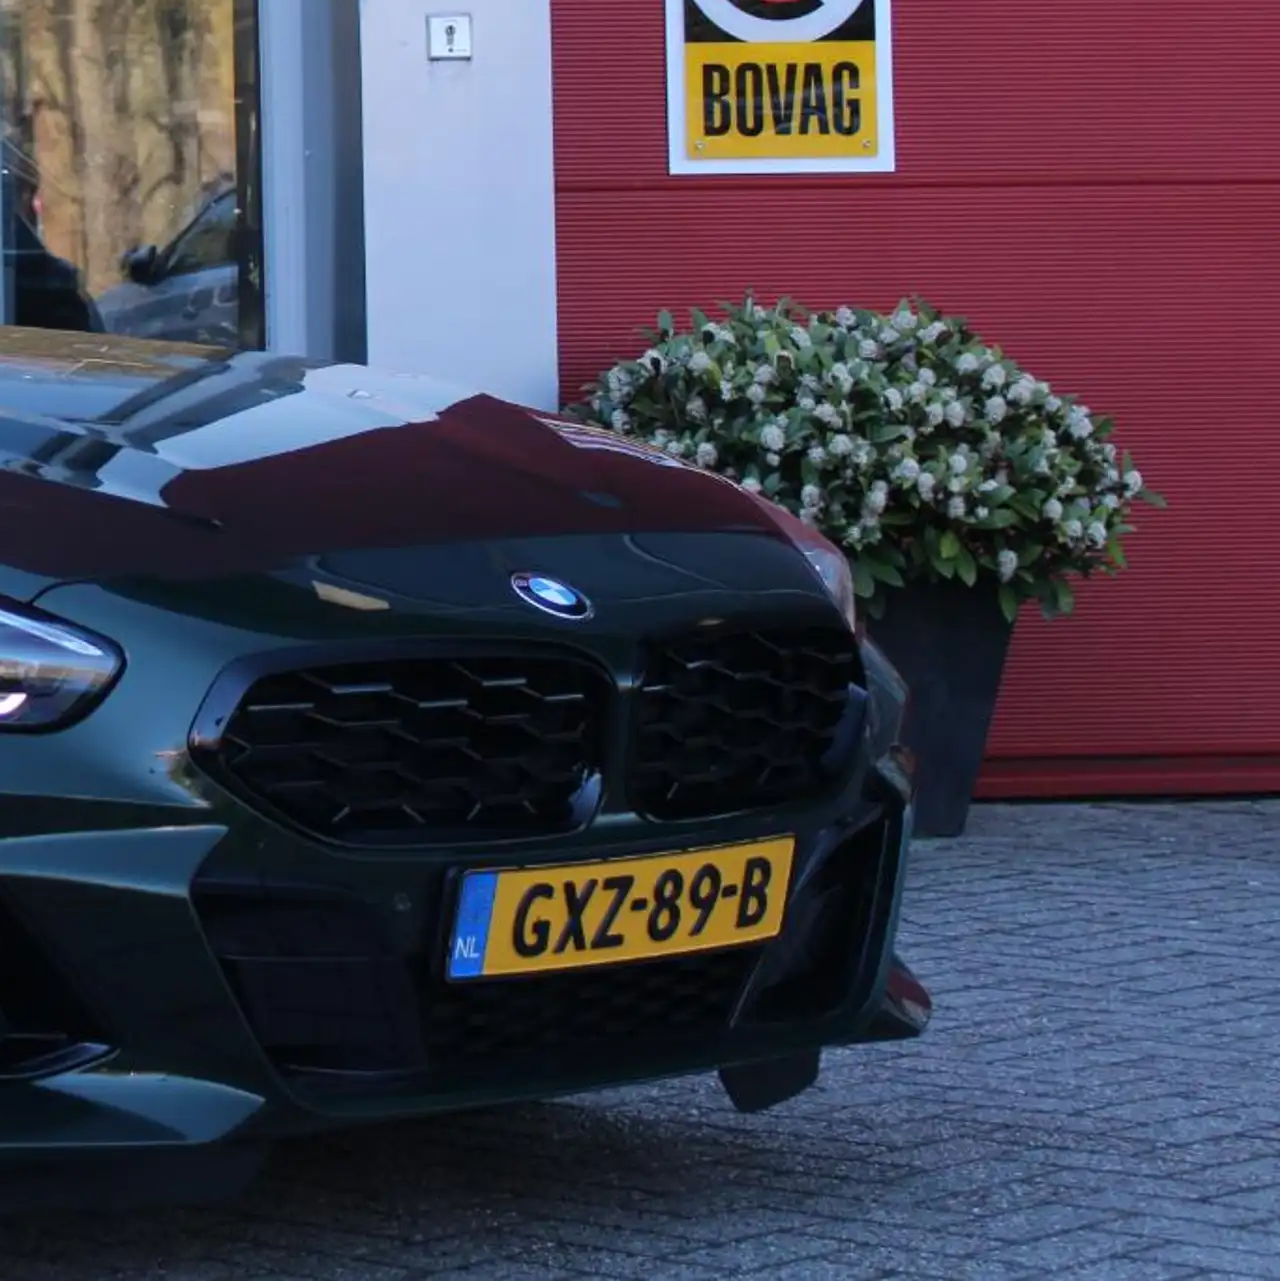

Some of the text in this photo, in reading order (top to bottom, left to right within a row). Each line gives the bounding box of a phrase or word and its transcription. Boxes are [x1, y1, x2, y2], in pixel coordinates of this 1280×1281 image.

[701, 60, 861, 138] BOVAG
[511, 855, 772, 958] GXZ-89-B
[454, 935, 480, 959] NL
